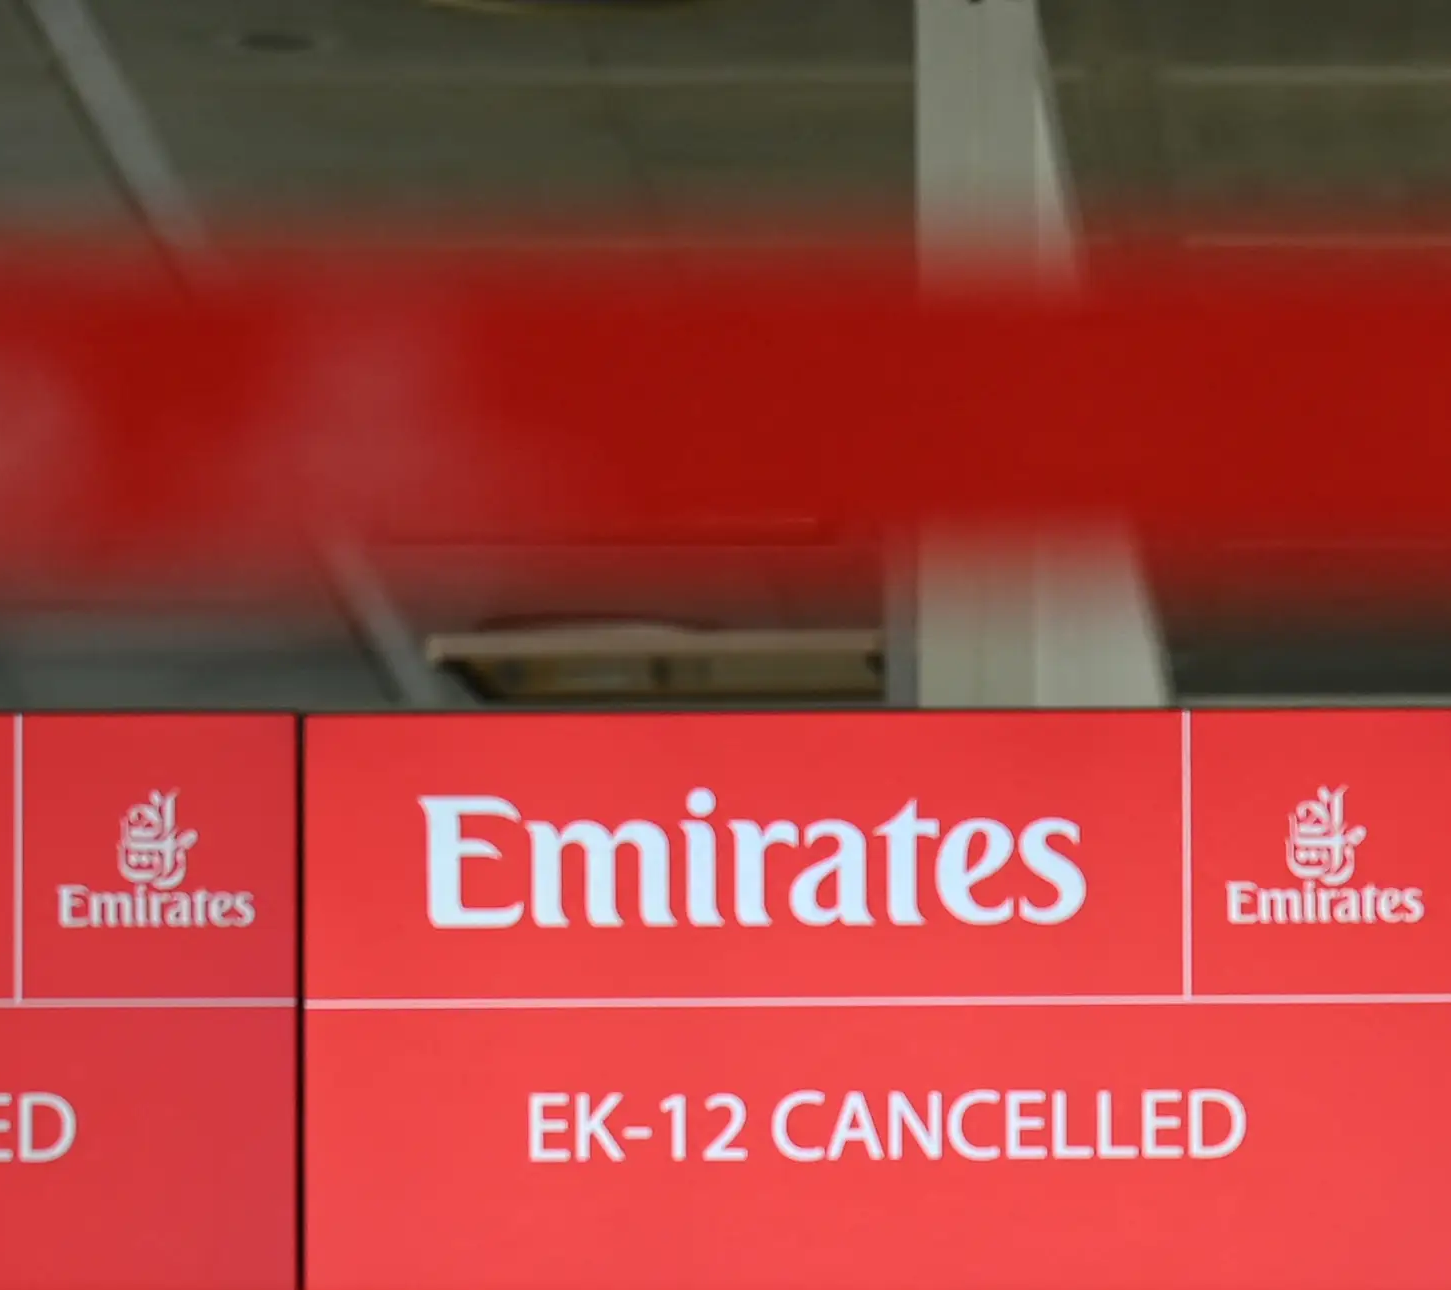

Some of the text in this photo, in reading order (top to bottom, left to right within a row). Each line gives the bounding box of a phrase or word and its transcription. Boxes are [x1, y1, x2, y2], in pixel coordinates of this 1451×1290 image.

[419, 788, 1086, 928] Emirates
[57, 883, 255, 927] Emirates
[1227, 879, 1424, 923] Emirates
[529, 1090, 1246, 1161] EK-12 CANCELLED
